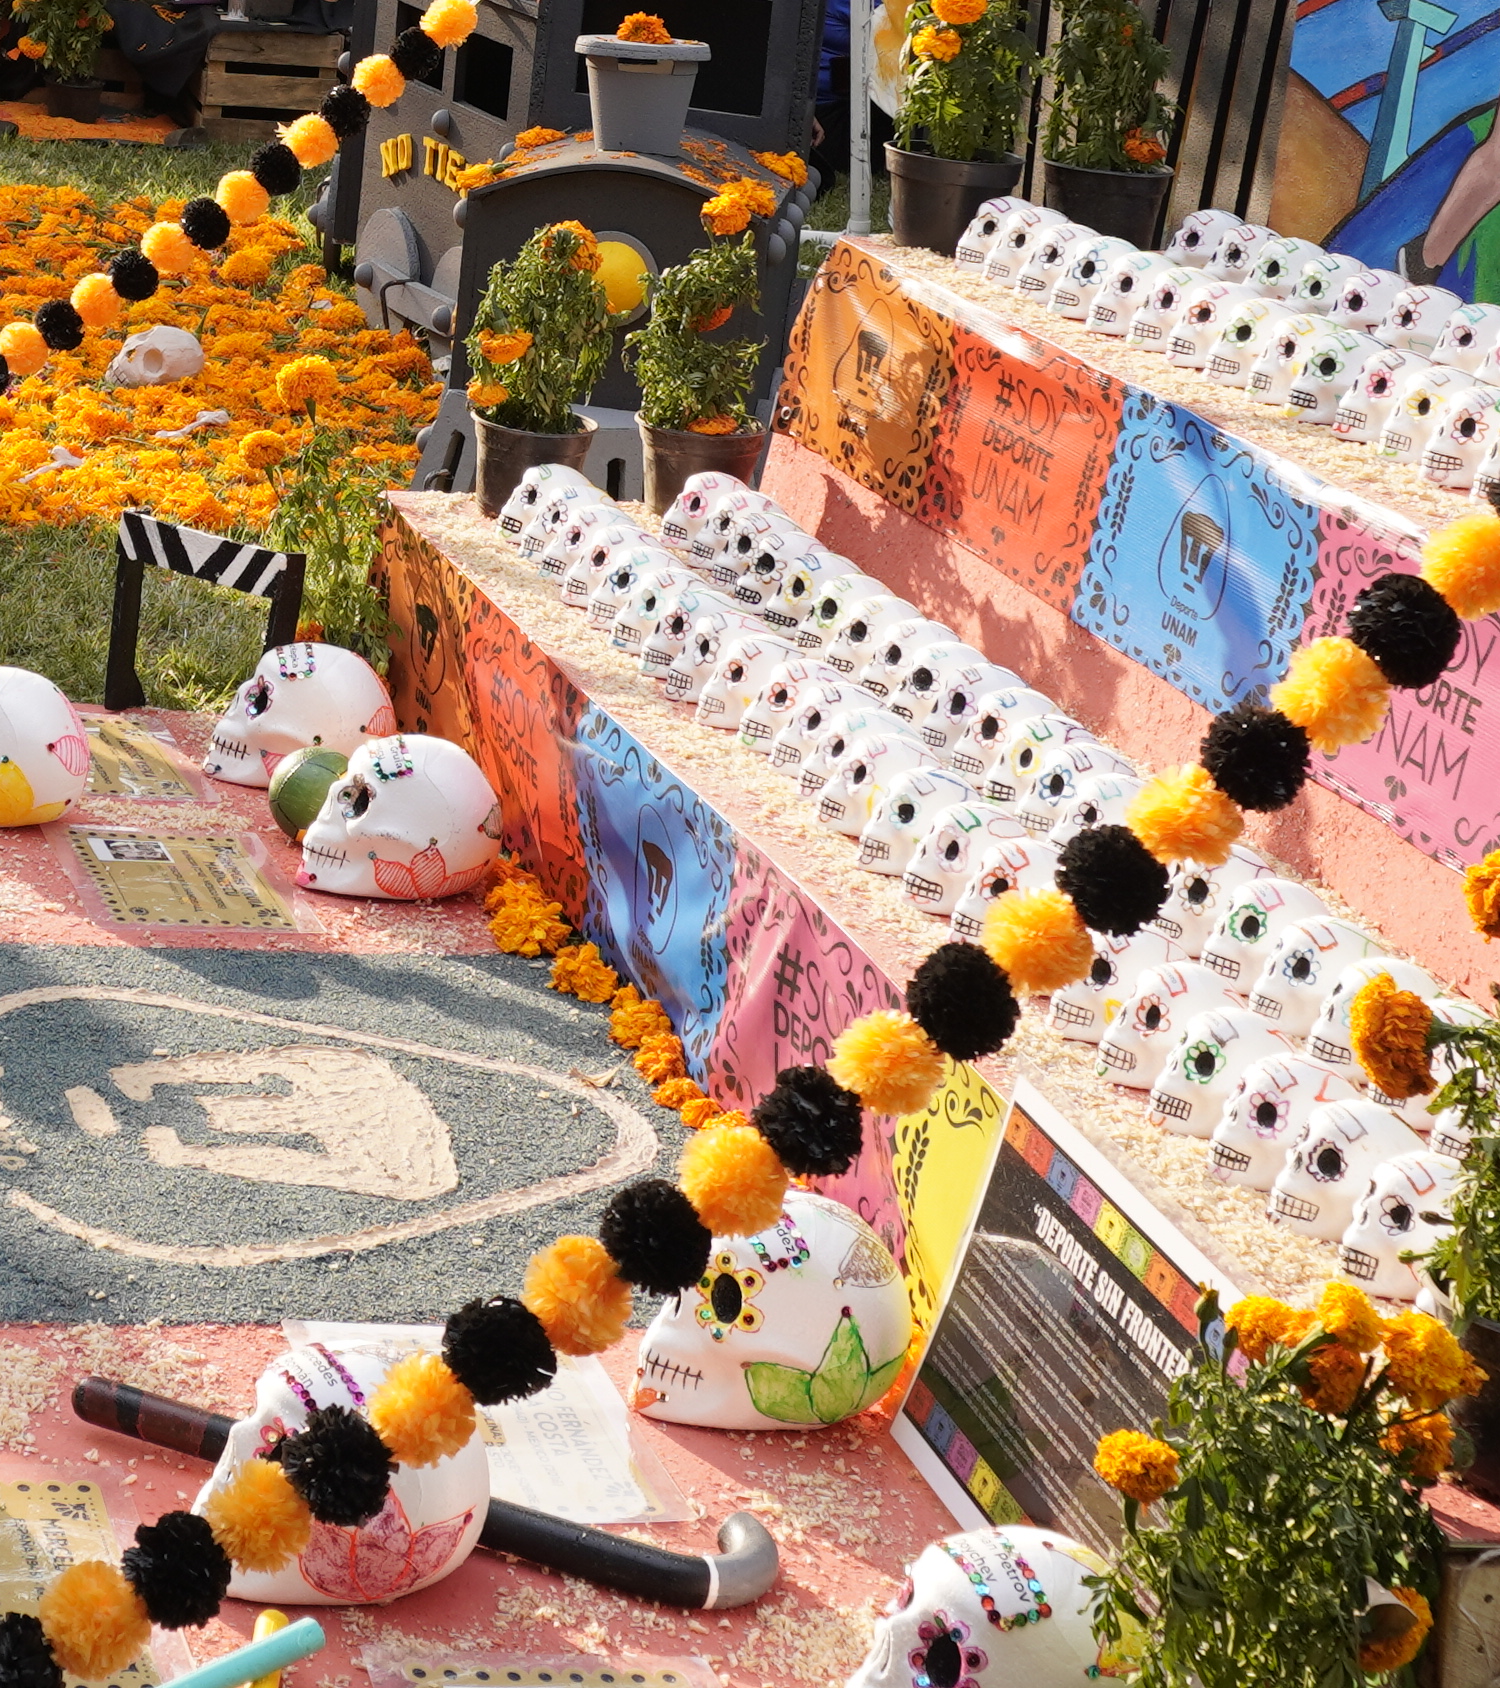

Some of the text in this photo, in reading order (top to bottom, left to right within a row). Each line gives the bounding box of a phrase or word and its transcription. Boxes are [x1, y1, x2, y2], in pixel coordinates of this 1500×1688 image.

[380, 133, 468, 193] NO TIE
[996, 369, 1068, 440] #SOY
[982, 419, 1054, 483] DEPORTE
[971, 451, 1047, 535] UNAM
[1161, 612, 1198, 647] UNAM
[1170, 595, 1199, 621] Deporte
[490, 668, 542, 751] #SOY
[1396, 678, 1483, 736] ORTE
[490, 715, 539, 791] DEPORTE
[1376, 707, 1471, 801] NAM
[774, 942, 849, 1038] #SO
[774, 1000, 832, 1069] DEPO
[1091, 1267, 1126, 1320] SIN
[1116, 1295, 1192, 1392] FRONTER
[530, 1412, 573, 1456] COSTA
[994, 1547, 1033, 1607] Petrov
